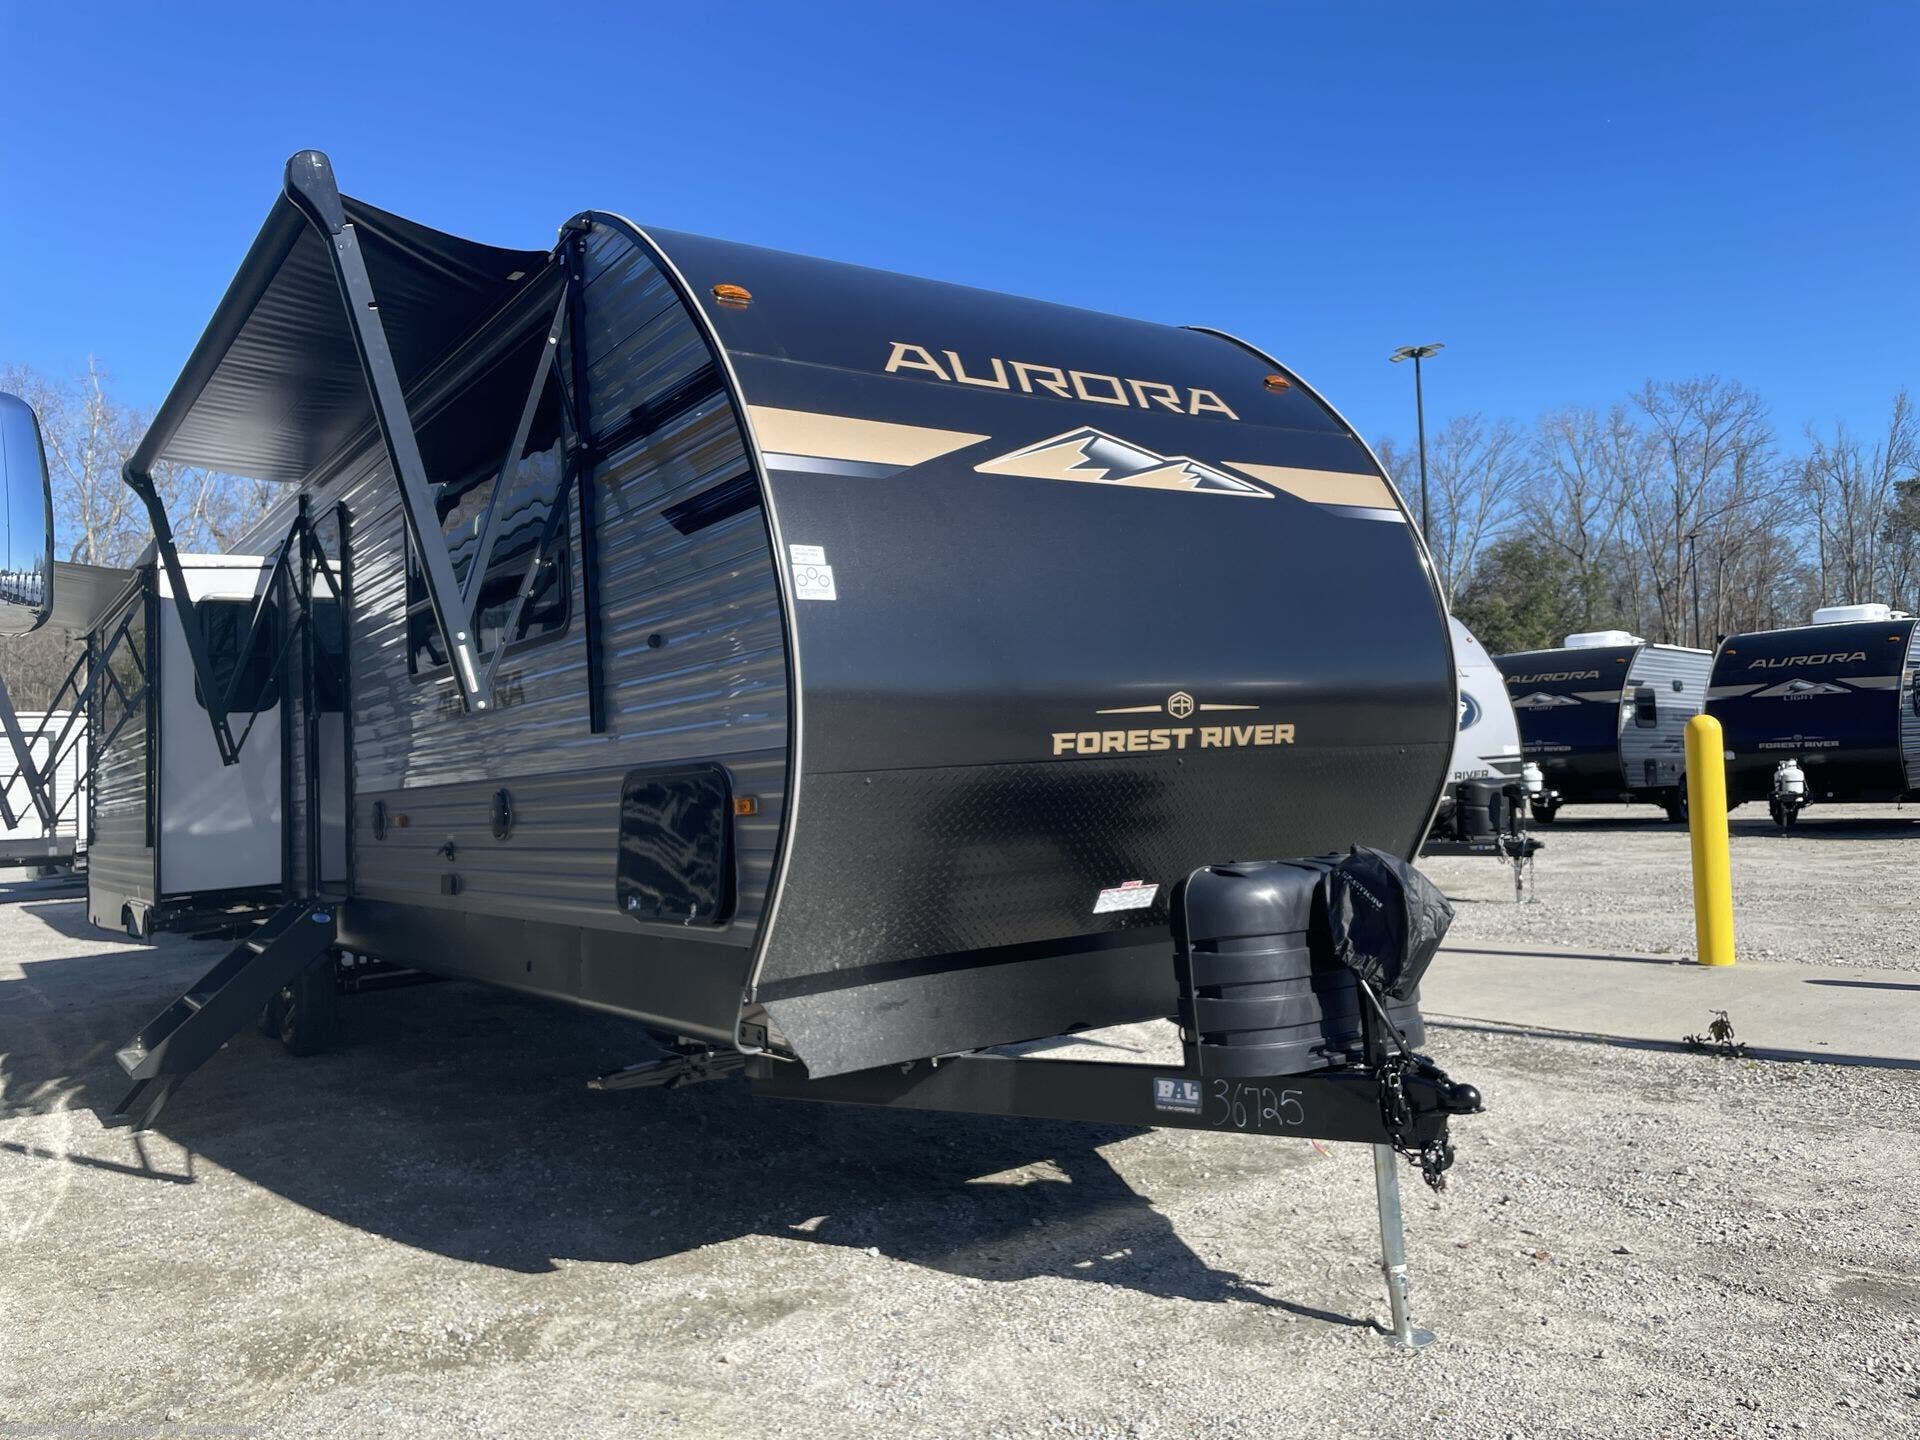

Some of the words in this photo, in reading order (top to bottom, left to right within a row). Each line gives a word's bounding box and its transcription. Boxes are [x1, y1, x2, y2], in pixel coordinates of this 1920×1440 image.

[885, 341, 1240, 421] AURORA
[1748, 651, 1867, 669] AURORA
[1507, 670, 1600, 684] AURORA
[1052, 728, 1193, 755] FOREST
[1200, 724, 1295, 748] RIVER
[1759, 741, 1802, 749] FOREST
[1804, 740, 1840, 748] RIVER
[1454, 769, 1489, 781] RIVER
[1212, 1078, 1305, 1128] 36725
